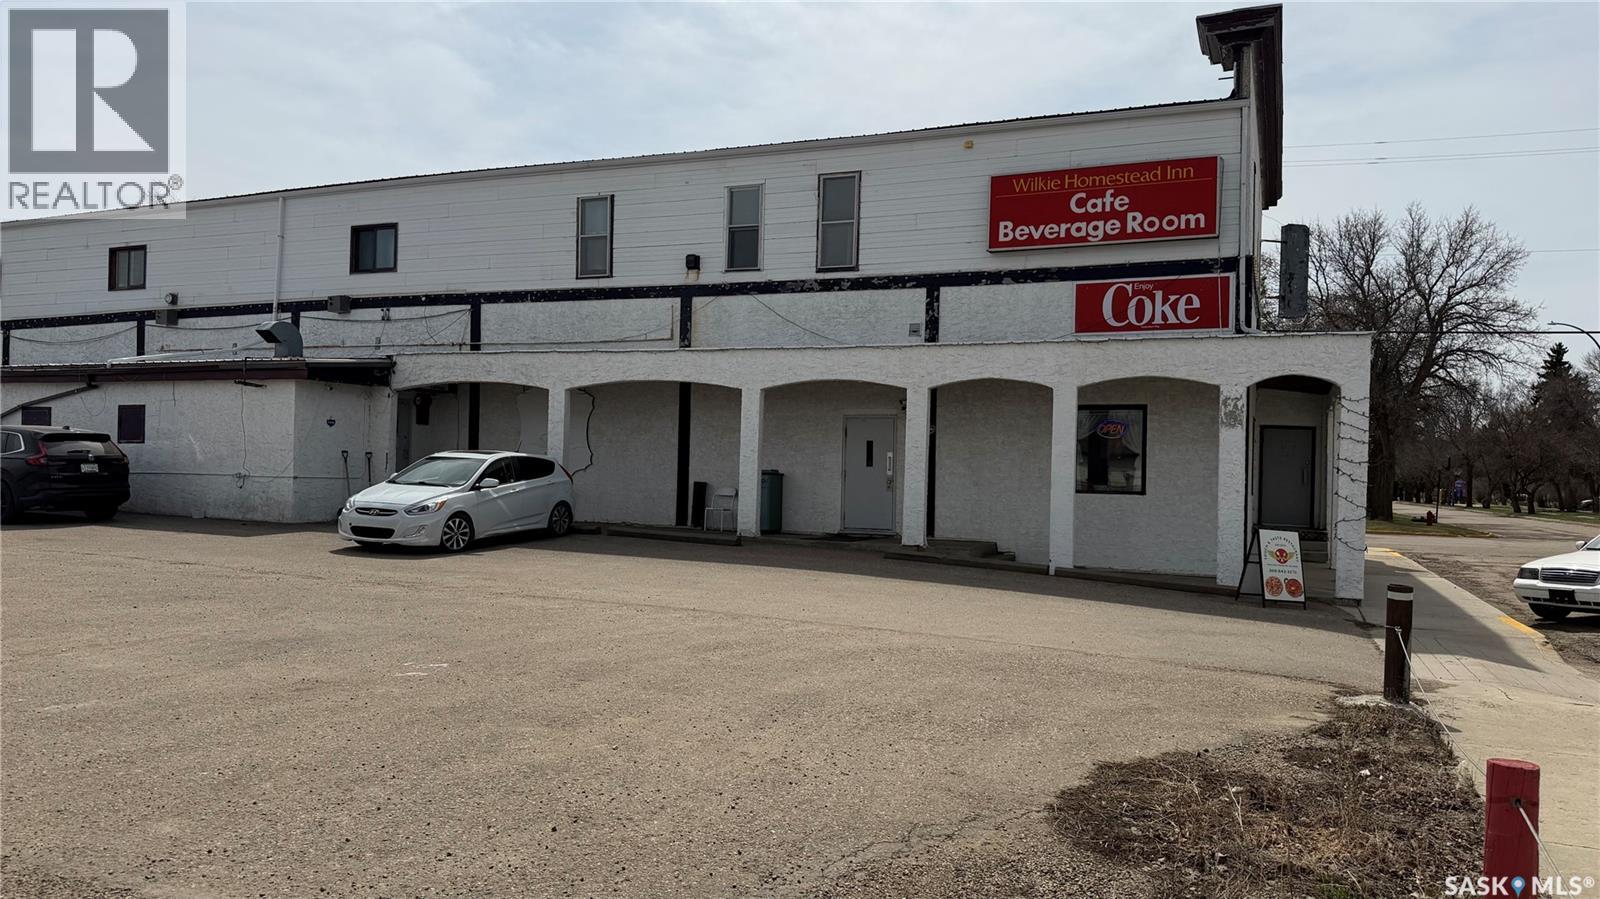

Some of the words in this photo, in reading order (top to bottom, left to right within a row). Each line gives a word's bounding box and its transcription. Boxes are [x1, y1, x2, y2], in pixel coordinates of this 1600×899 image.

[1012, 177, 1061, 193] Wilkie
[1064, 166, 1161, 189] Homestead
[1167, 165, 1194, 180] Inn
[1069, 189, 1130, 214] Cafe
[998, 219, 1121, 242] Beverage
[1126, 212, 1205, 234] Room
[1133, 282, 1154, 291] Enjoy
[1102, 283, 1201, 327] Coke
[1099, 424, 1126, 433] OPEN
